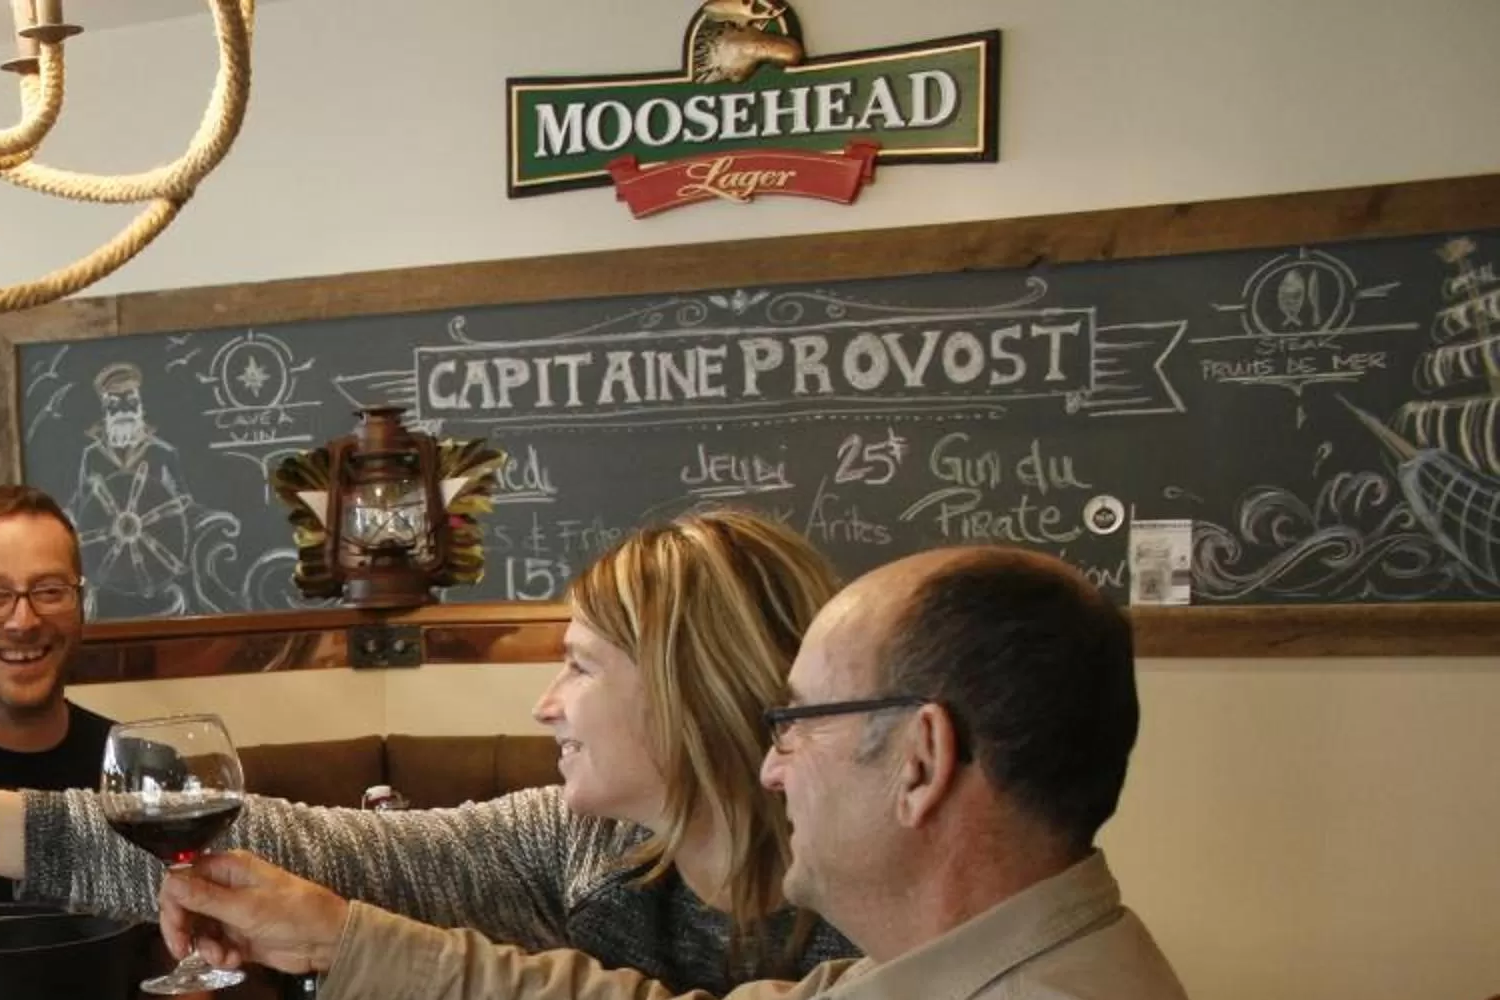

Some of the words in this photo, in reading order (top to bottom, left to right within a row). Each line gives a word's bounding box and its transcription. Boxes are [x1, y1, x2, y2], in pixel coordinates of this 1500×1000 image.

[533, 69, 958, 158] MOOSEHEAD
[677, 157, 797, 204] Lager
[426, 345, 728, 411] CAPITAINE
[739, 321, 1082, 396] PROVOST
[1332, 351, 1387, 371] MER
[1015, 437, 1093, 495] du
